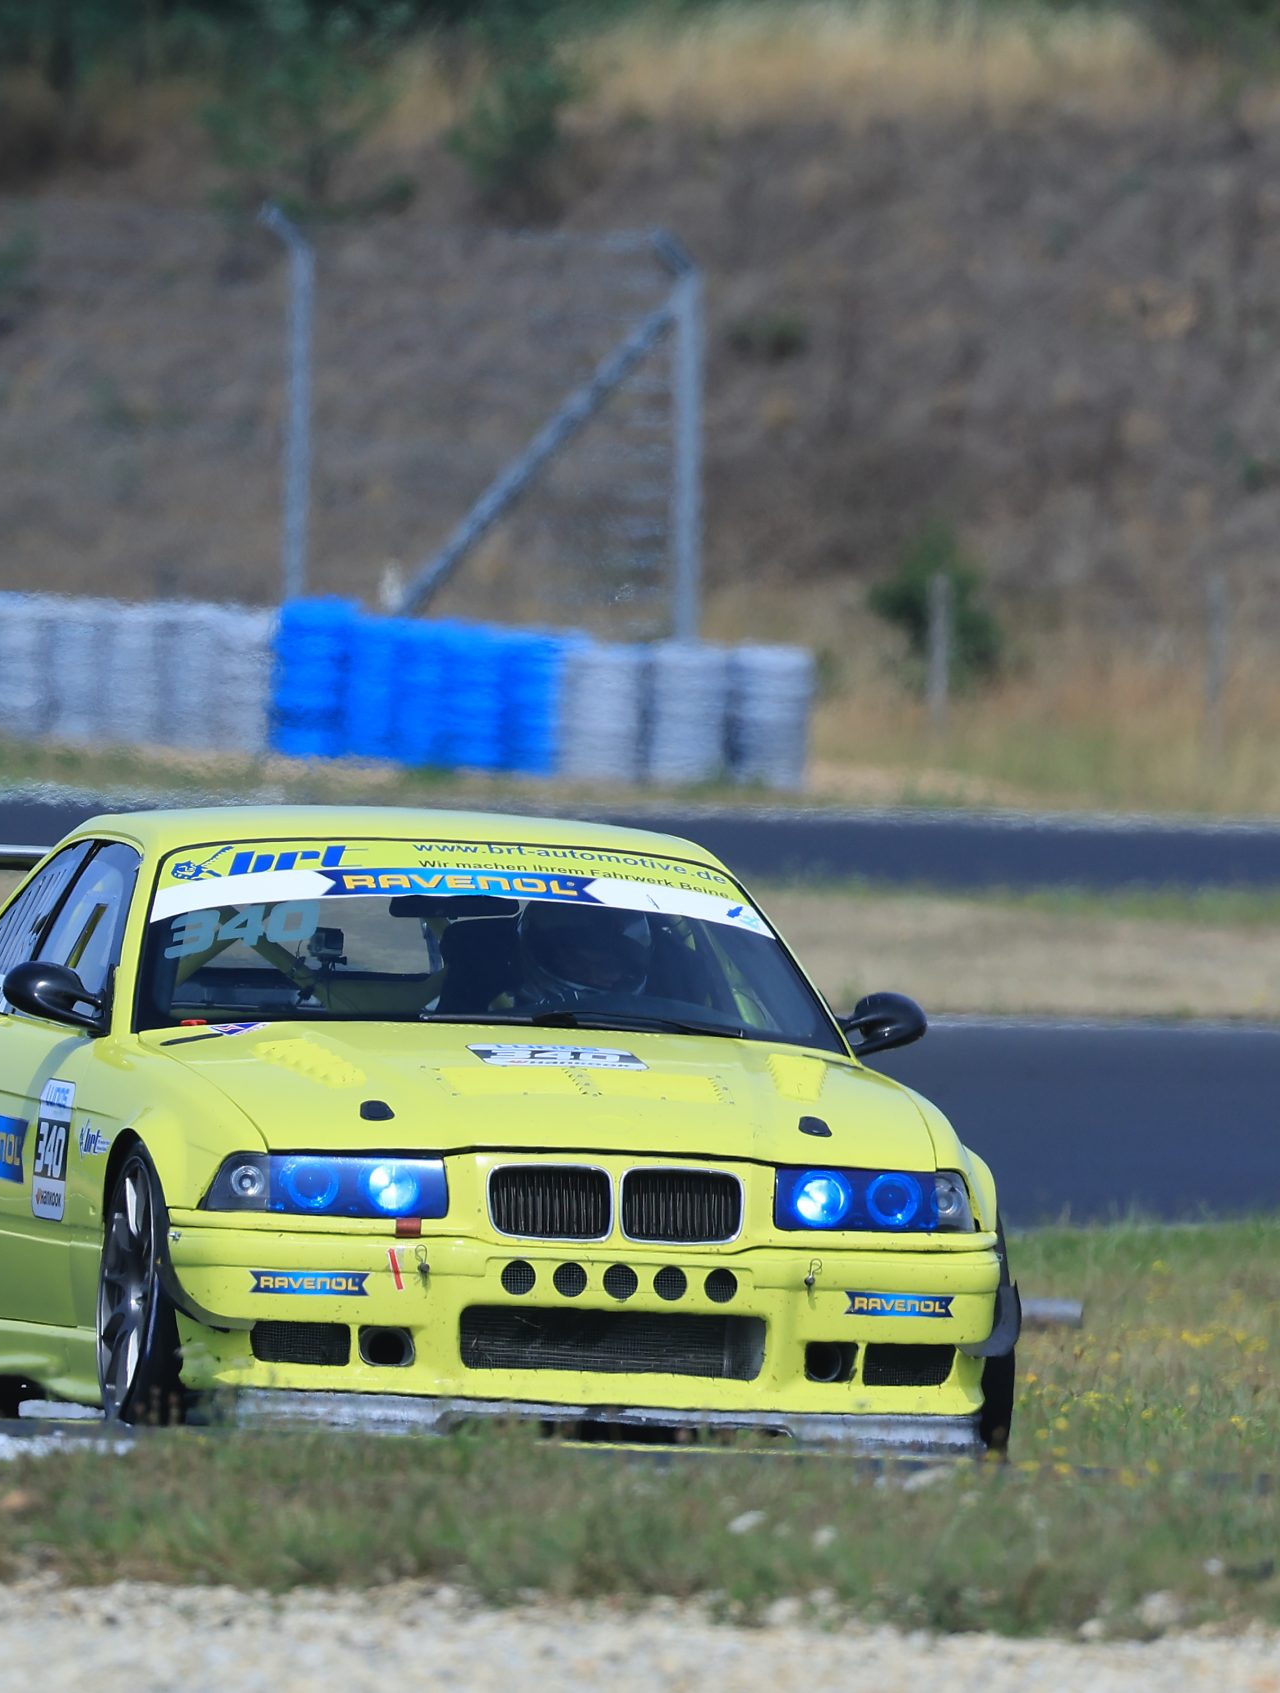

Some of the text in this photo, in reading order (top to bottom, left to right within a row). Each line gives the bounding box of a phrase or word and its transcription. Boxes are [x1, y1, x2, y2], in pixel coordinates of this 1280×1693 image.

[228, 845, 360, 876] brt
[413, 844, 727, 885] www.brt-automotive.de
[418, 860, 448, 869] Wir
[455, 861, 528, 872] machen
[532, 863, 585, 876] Ihrem
[590, 868, 674, 889] Fahrwerk
[342, 873, 579, 896] RAVENOL
[164, 900, 320, 960] 340
[488, 1050, 620, 1063] 340
[34, 1121, 66, 1179] 340
[260, 1276, 359, 1291] RAVENOL
[854, 1296, 946, 1313] RAVENOL
